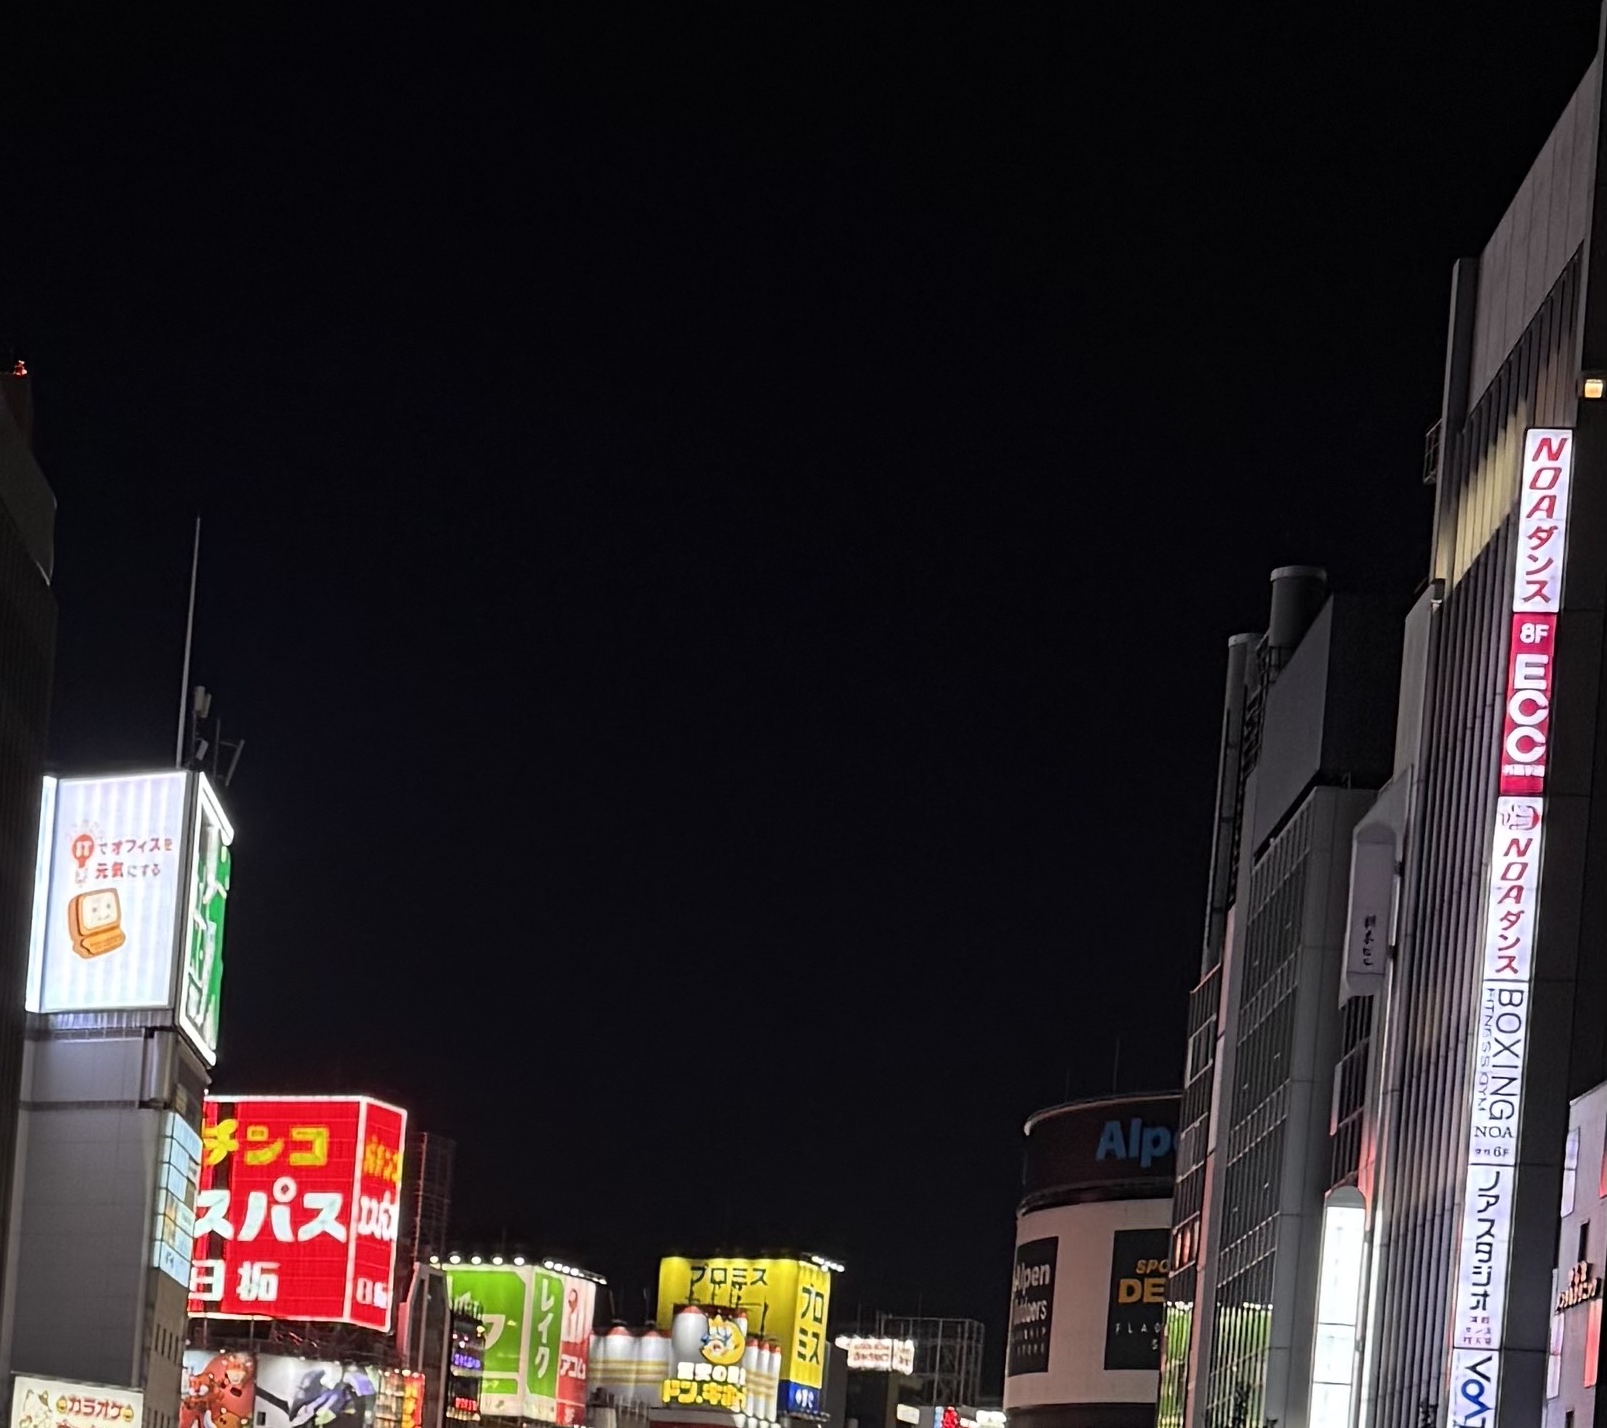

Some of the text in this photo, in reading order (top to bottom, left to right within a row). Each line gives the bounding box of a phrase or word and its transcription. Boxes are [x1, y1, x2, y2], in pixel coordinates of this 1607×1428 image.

[1521, 437, 1569, 603] NOAダンス
[1519, 622, 1550, 644] 8F
[1505, 653, 1550, 763] ECC
[1488, 988, 1525, 1121] BOXING
[1096, 1117, 1179, 1169] Alp
[1474, 1126, 1514, 1139] NOA
[690, 1265, 768, 1286] プロミス
[534, 1278, 555, 1379] レイク
[560, 1353, 587, 1380] アコム
[68, 1395, 124, 1420] カラオケ
